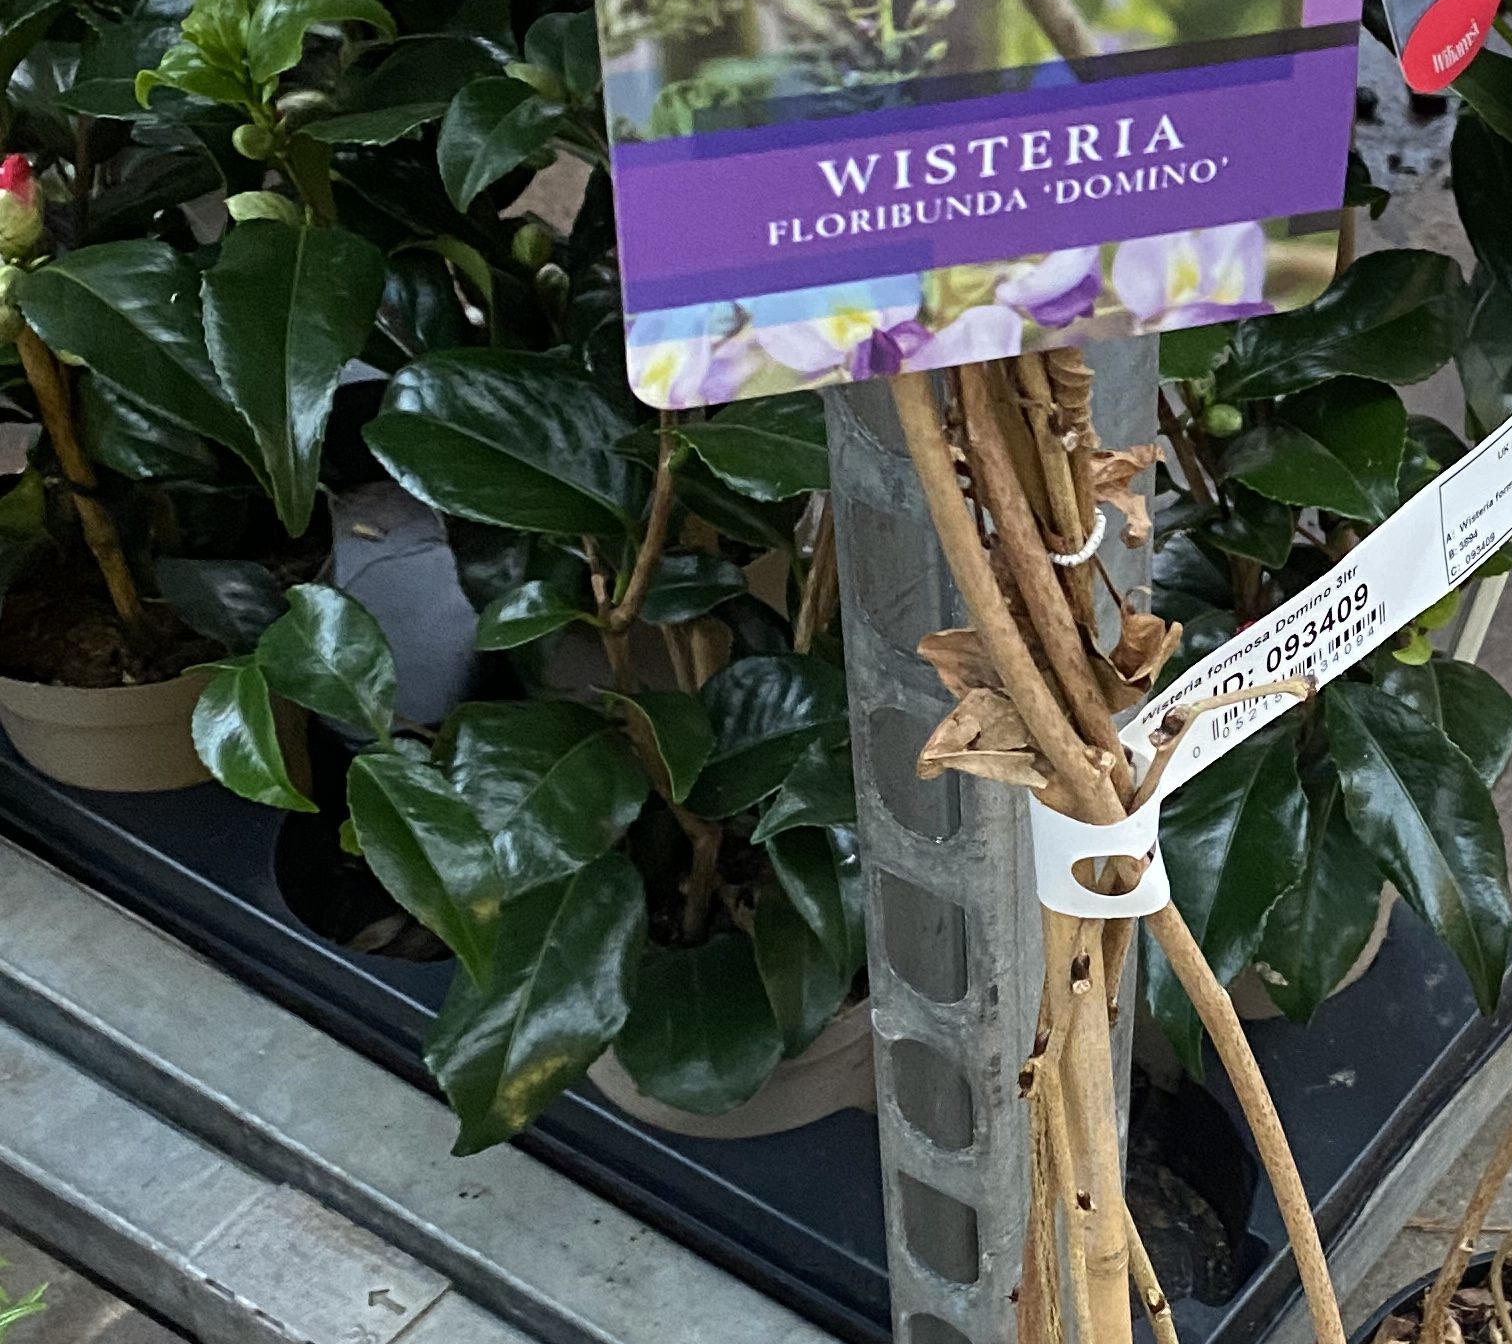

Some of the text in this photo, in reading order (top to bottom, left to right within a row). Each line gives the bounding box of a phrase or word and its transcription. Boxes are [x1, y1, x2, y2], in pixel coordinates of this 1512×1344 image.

[816, 113, 1187, 199] WISTERIA
[767, 186, 1029, 247] FLORIBUNDA
[1142, 673, 1203, 725] Wisteria
[1207, 631, 1271, 679] formosa
[1275, 586, 1332, 634] Domino
[1212, 583, 1370, 699] ID: 093409
